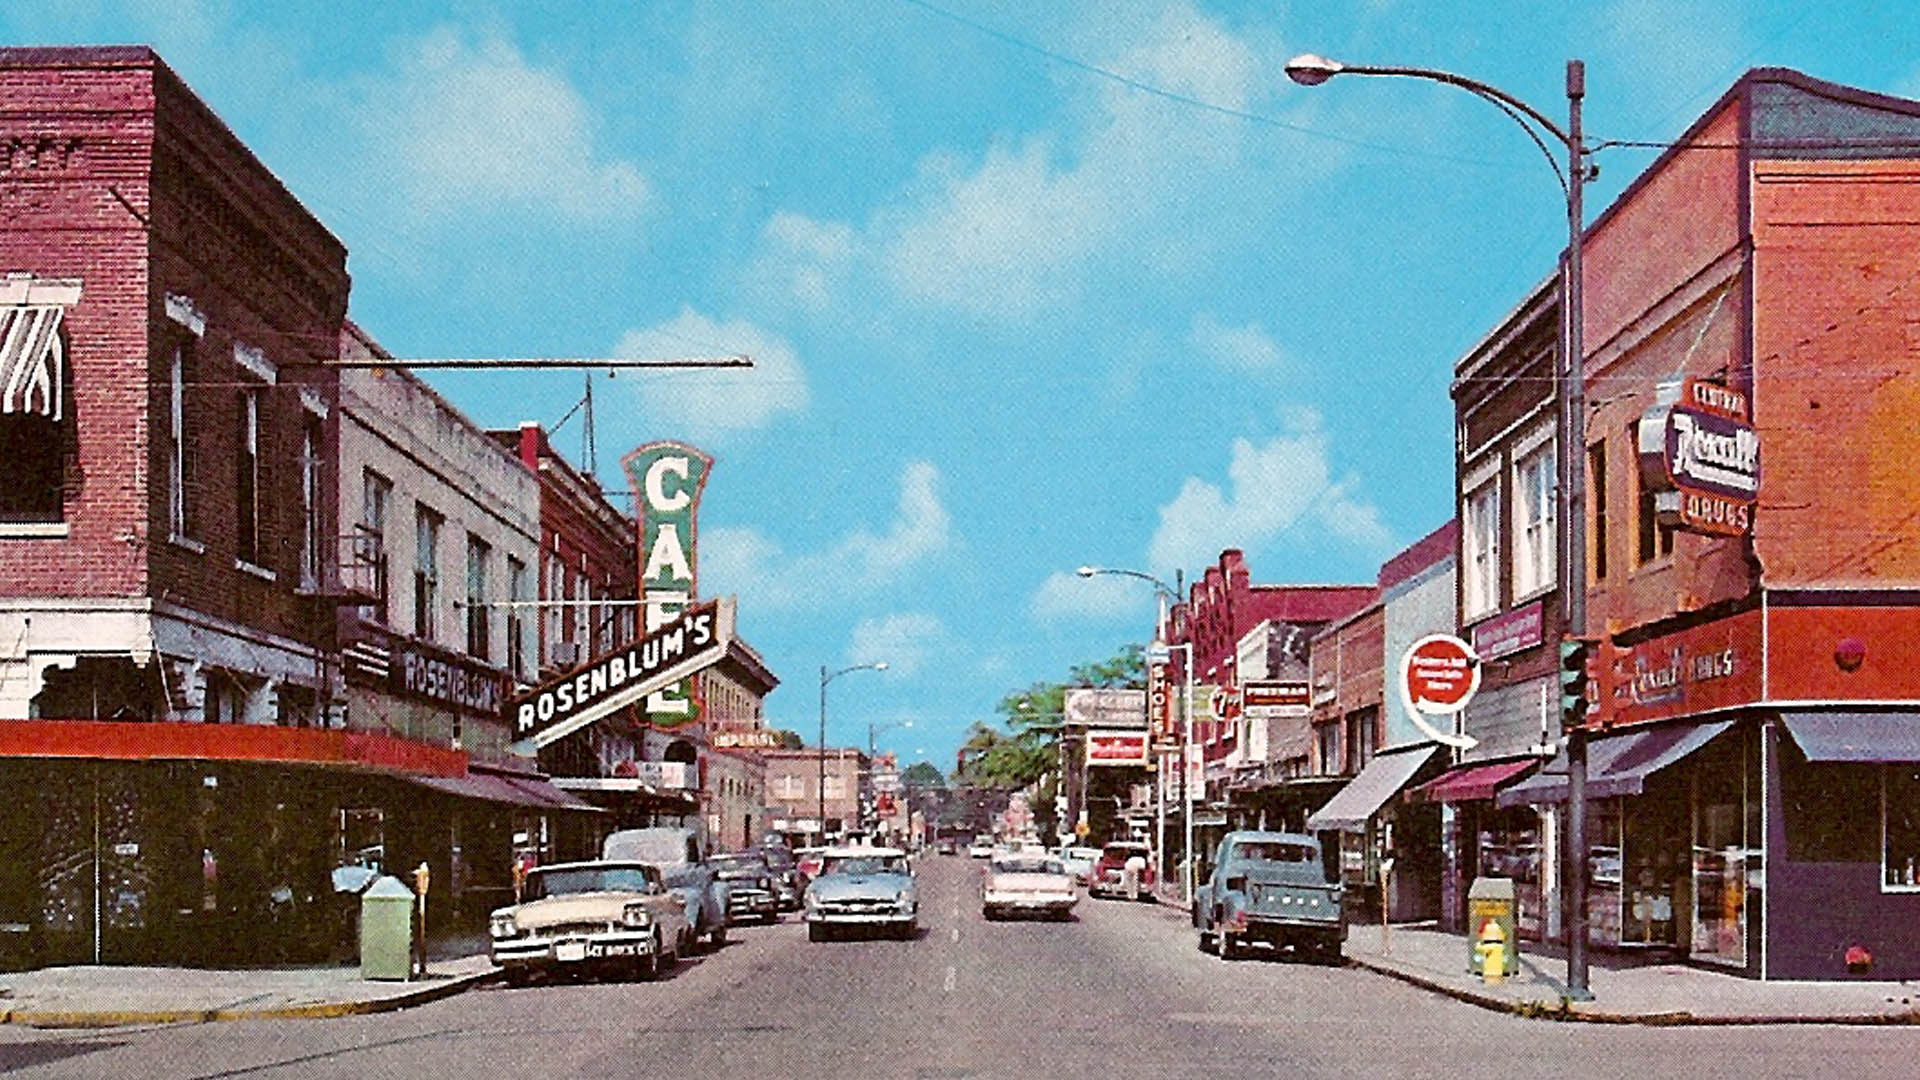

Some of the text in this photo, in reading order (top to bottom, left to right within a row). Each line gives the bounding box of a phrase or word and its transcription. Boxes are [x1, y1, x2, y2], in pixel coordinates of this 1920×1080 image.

[1672, 413, 1760, 490] Rexall
[1687, 495, 1749, 530] DRUGS
[518, 615, 711, 732] ROSENBLUM'S
